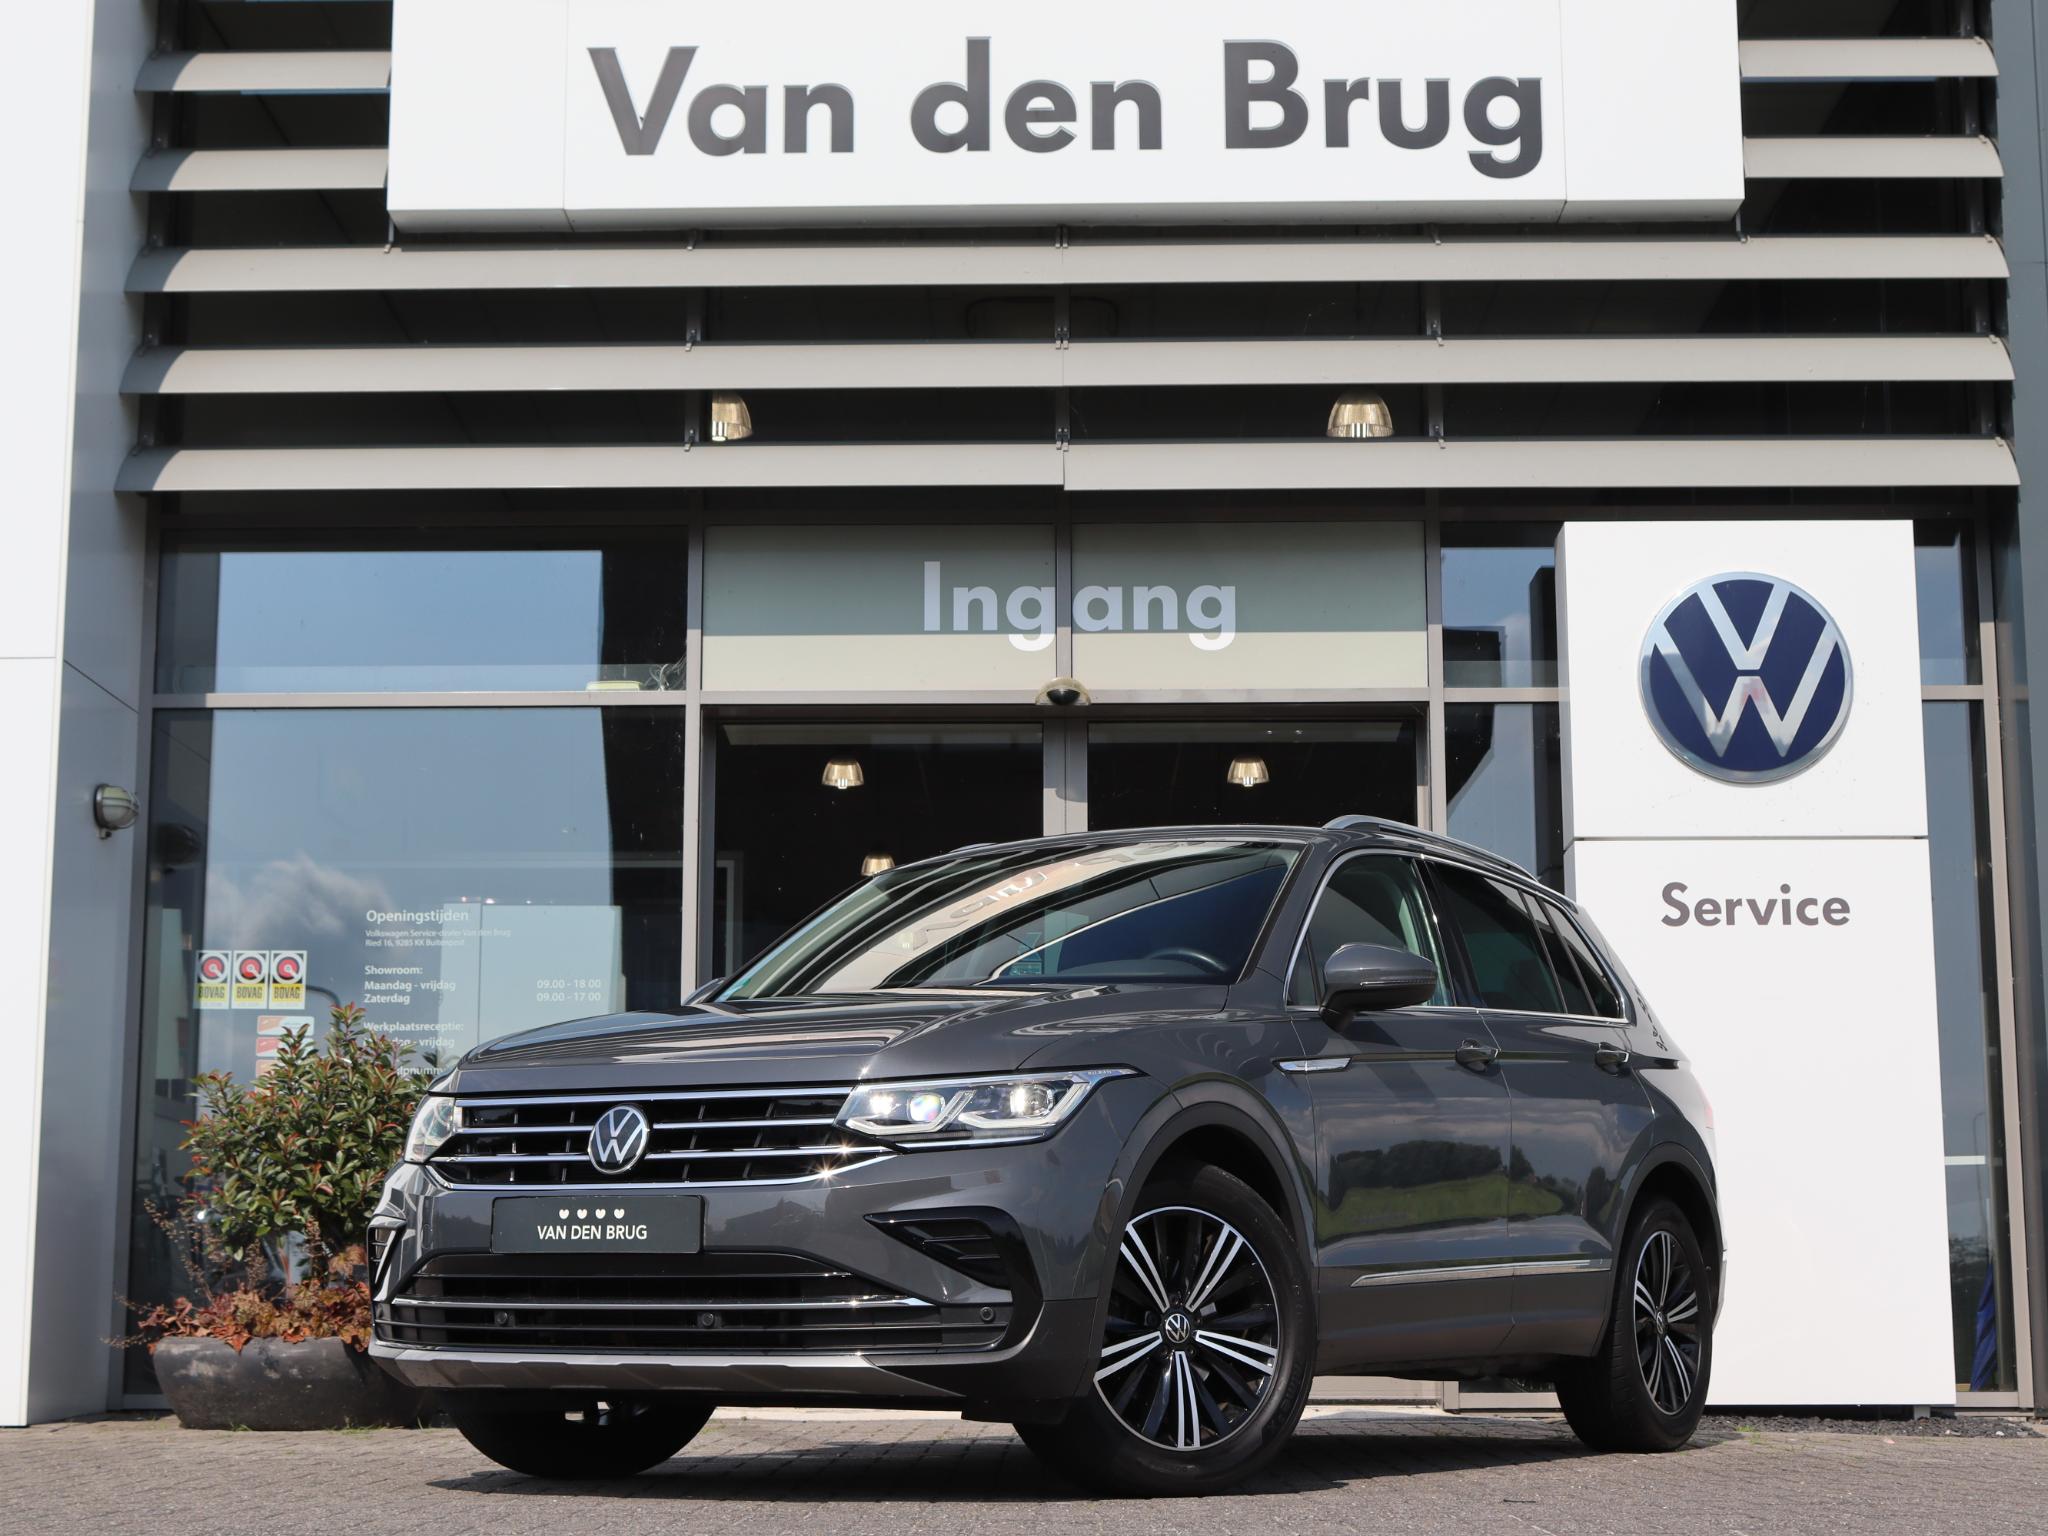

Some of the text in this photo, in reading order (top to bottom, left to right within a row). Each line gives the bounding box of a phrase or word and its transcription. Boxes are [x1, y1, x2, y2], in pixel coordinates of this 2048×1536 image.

[587, 36, 1543, 179] Van den Brug
[924, 560, 1236, 651] Ingang
[1661, 881, 1850, 927] Service
[366, 909, 469, 924] Openingstijden
[364, 964, 423, 975] Showroom:
[364, 980, 412, 992] Maandag
[421, 980, 456, 992] vrijdag
[536, 979, 565, 989] 09.00
[198, 986, 225, 999] BOVAG
[236, 986, 263, 999] BOVAG
[274, 986, 300, 999] BOVAG
[363, 993, 410, 1005] Zaterdag
[536, 992, 565, 1001] 09.00
[363, 1021, 465, 1033] Werkplaatsreceptie:
[419, 1036, 455, 1048] vrijdag
[537, 1225, 648, 1240] VAN DEN BRUG
